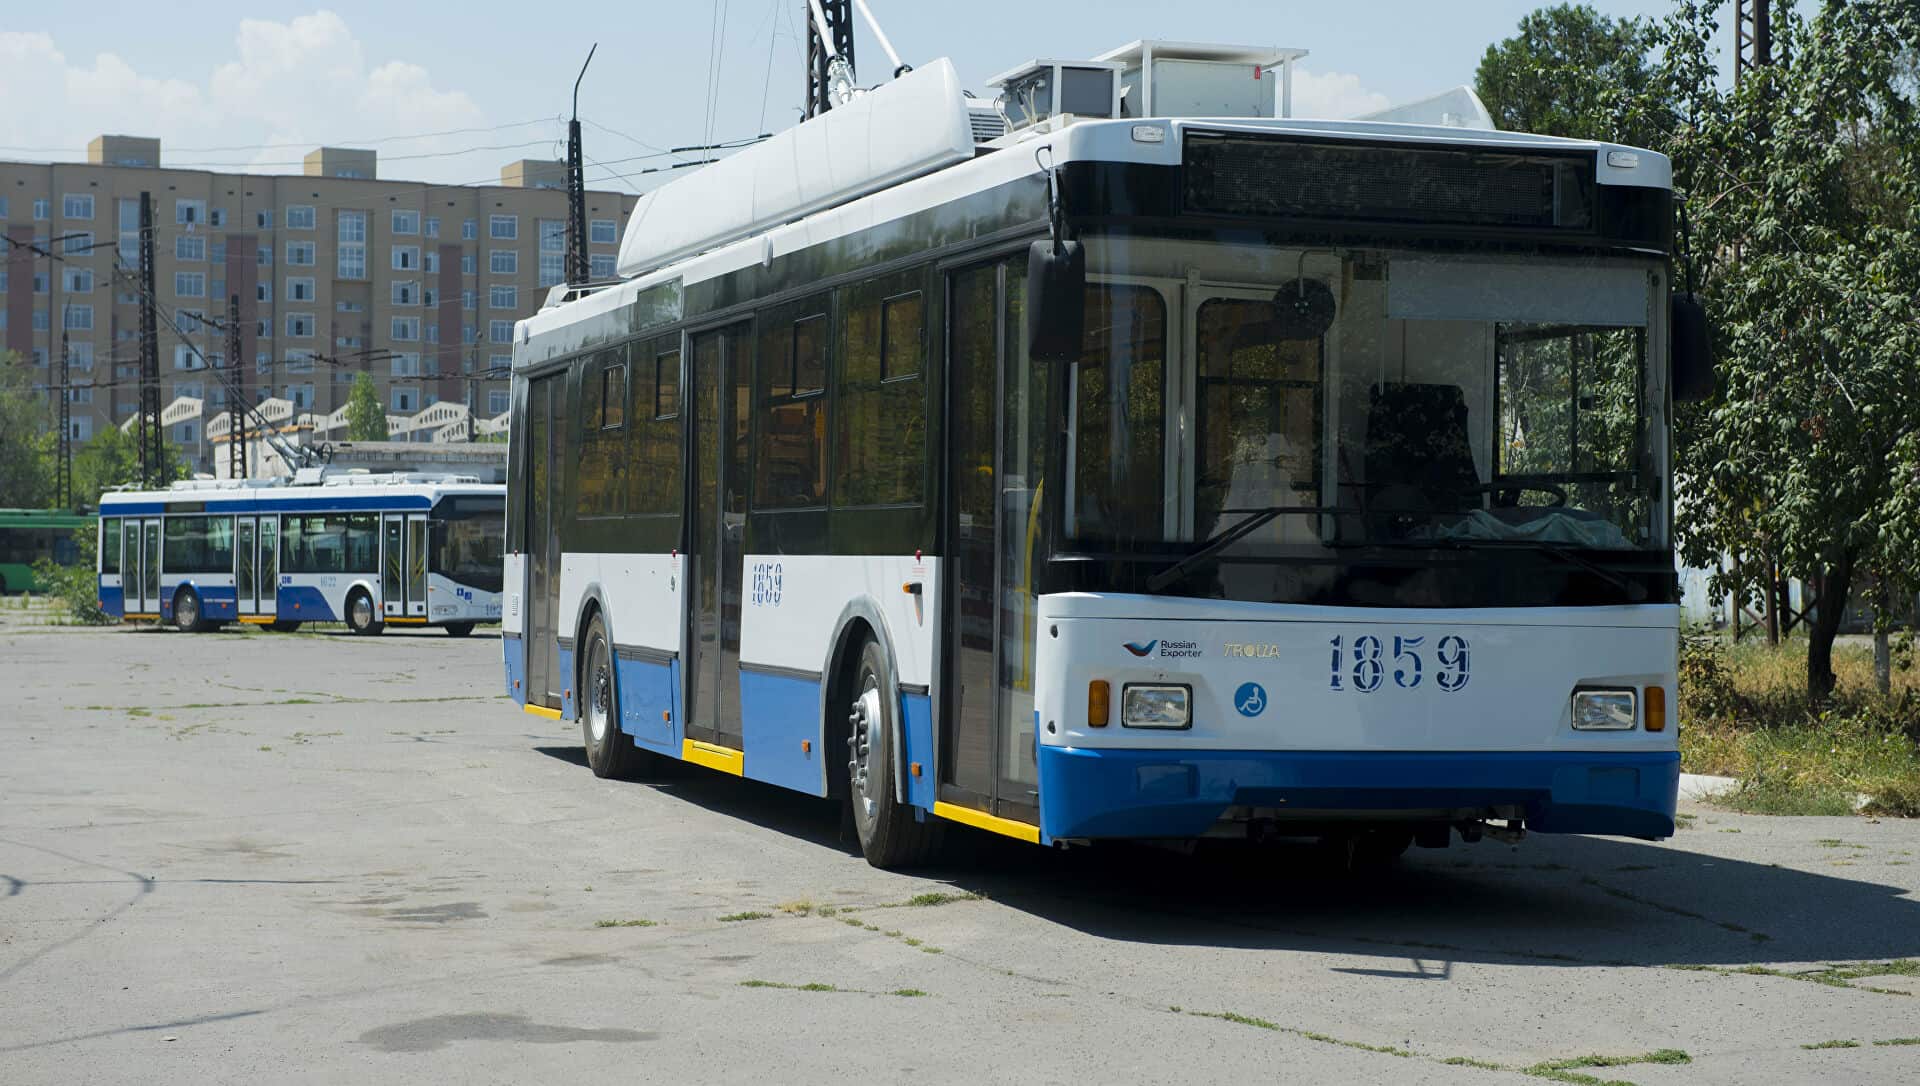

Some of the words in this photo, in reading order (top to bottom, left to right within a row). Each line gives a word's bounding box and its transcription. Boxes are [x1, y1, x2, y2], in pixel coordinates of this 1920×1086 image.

[752, 563, 782, 606] 1859
[1160, 640, 1197, 649] Russian
[1160, 649, 1202, 658] Exporter
[1330, 634, 1470, 692] 1859
